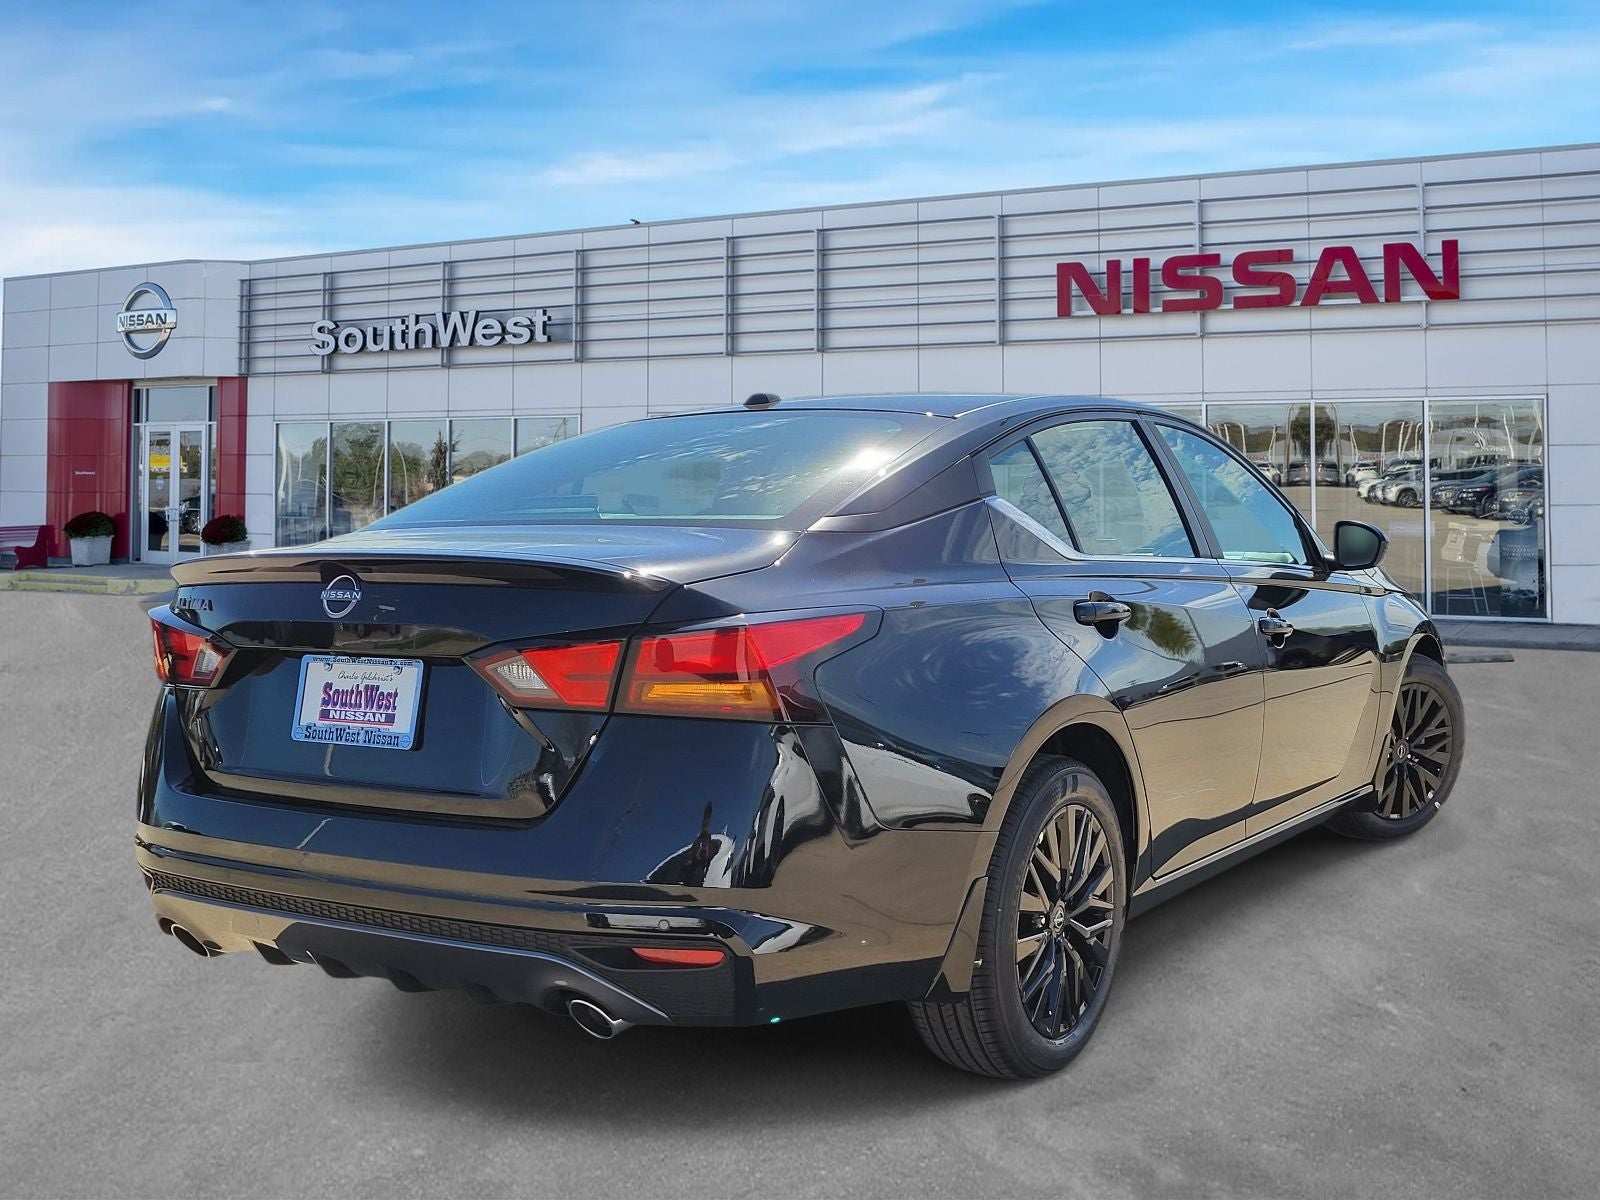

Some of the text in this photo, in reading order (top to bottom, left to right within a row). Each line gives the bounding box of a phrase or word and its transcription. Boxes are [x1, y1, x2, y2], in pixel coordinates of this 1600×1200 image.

[1056, 239, 1461, 318] NISSAN
[118, 312, 168, 328] NISSAN
[309, 308, 552, 357] SouthWest
[321, 589, 362, 601] NISSAN
[320, 681, 399, 712] SouthWest
[329, 709, 386, 722] NISSAN
[304, 725, 400, 747] SouthWest Nissan
